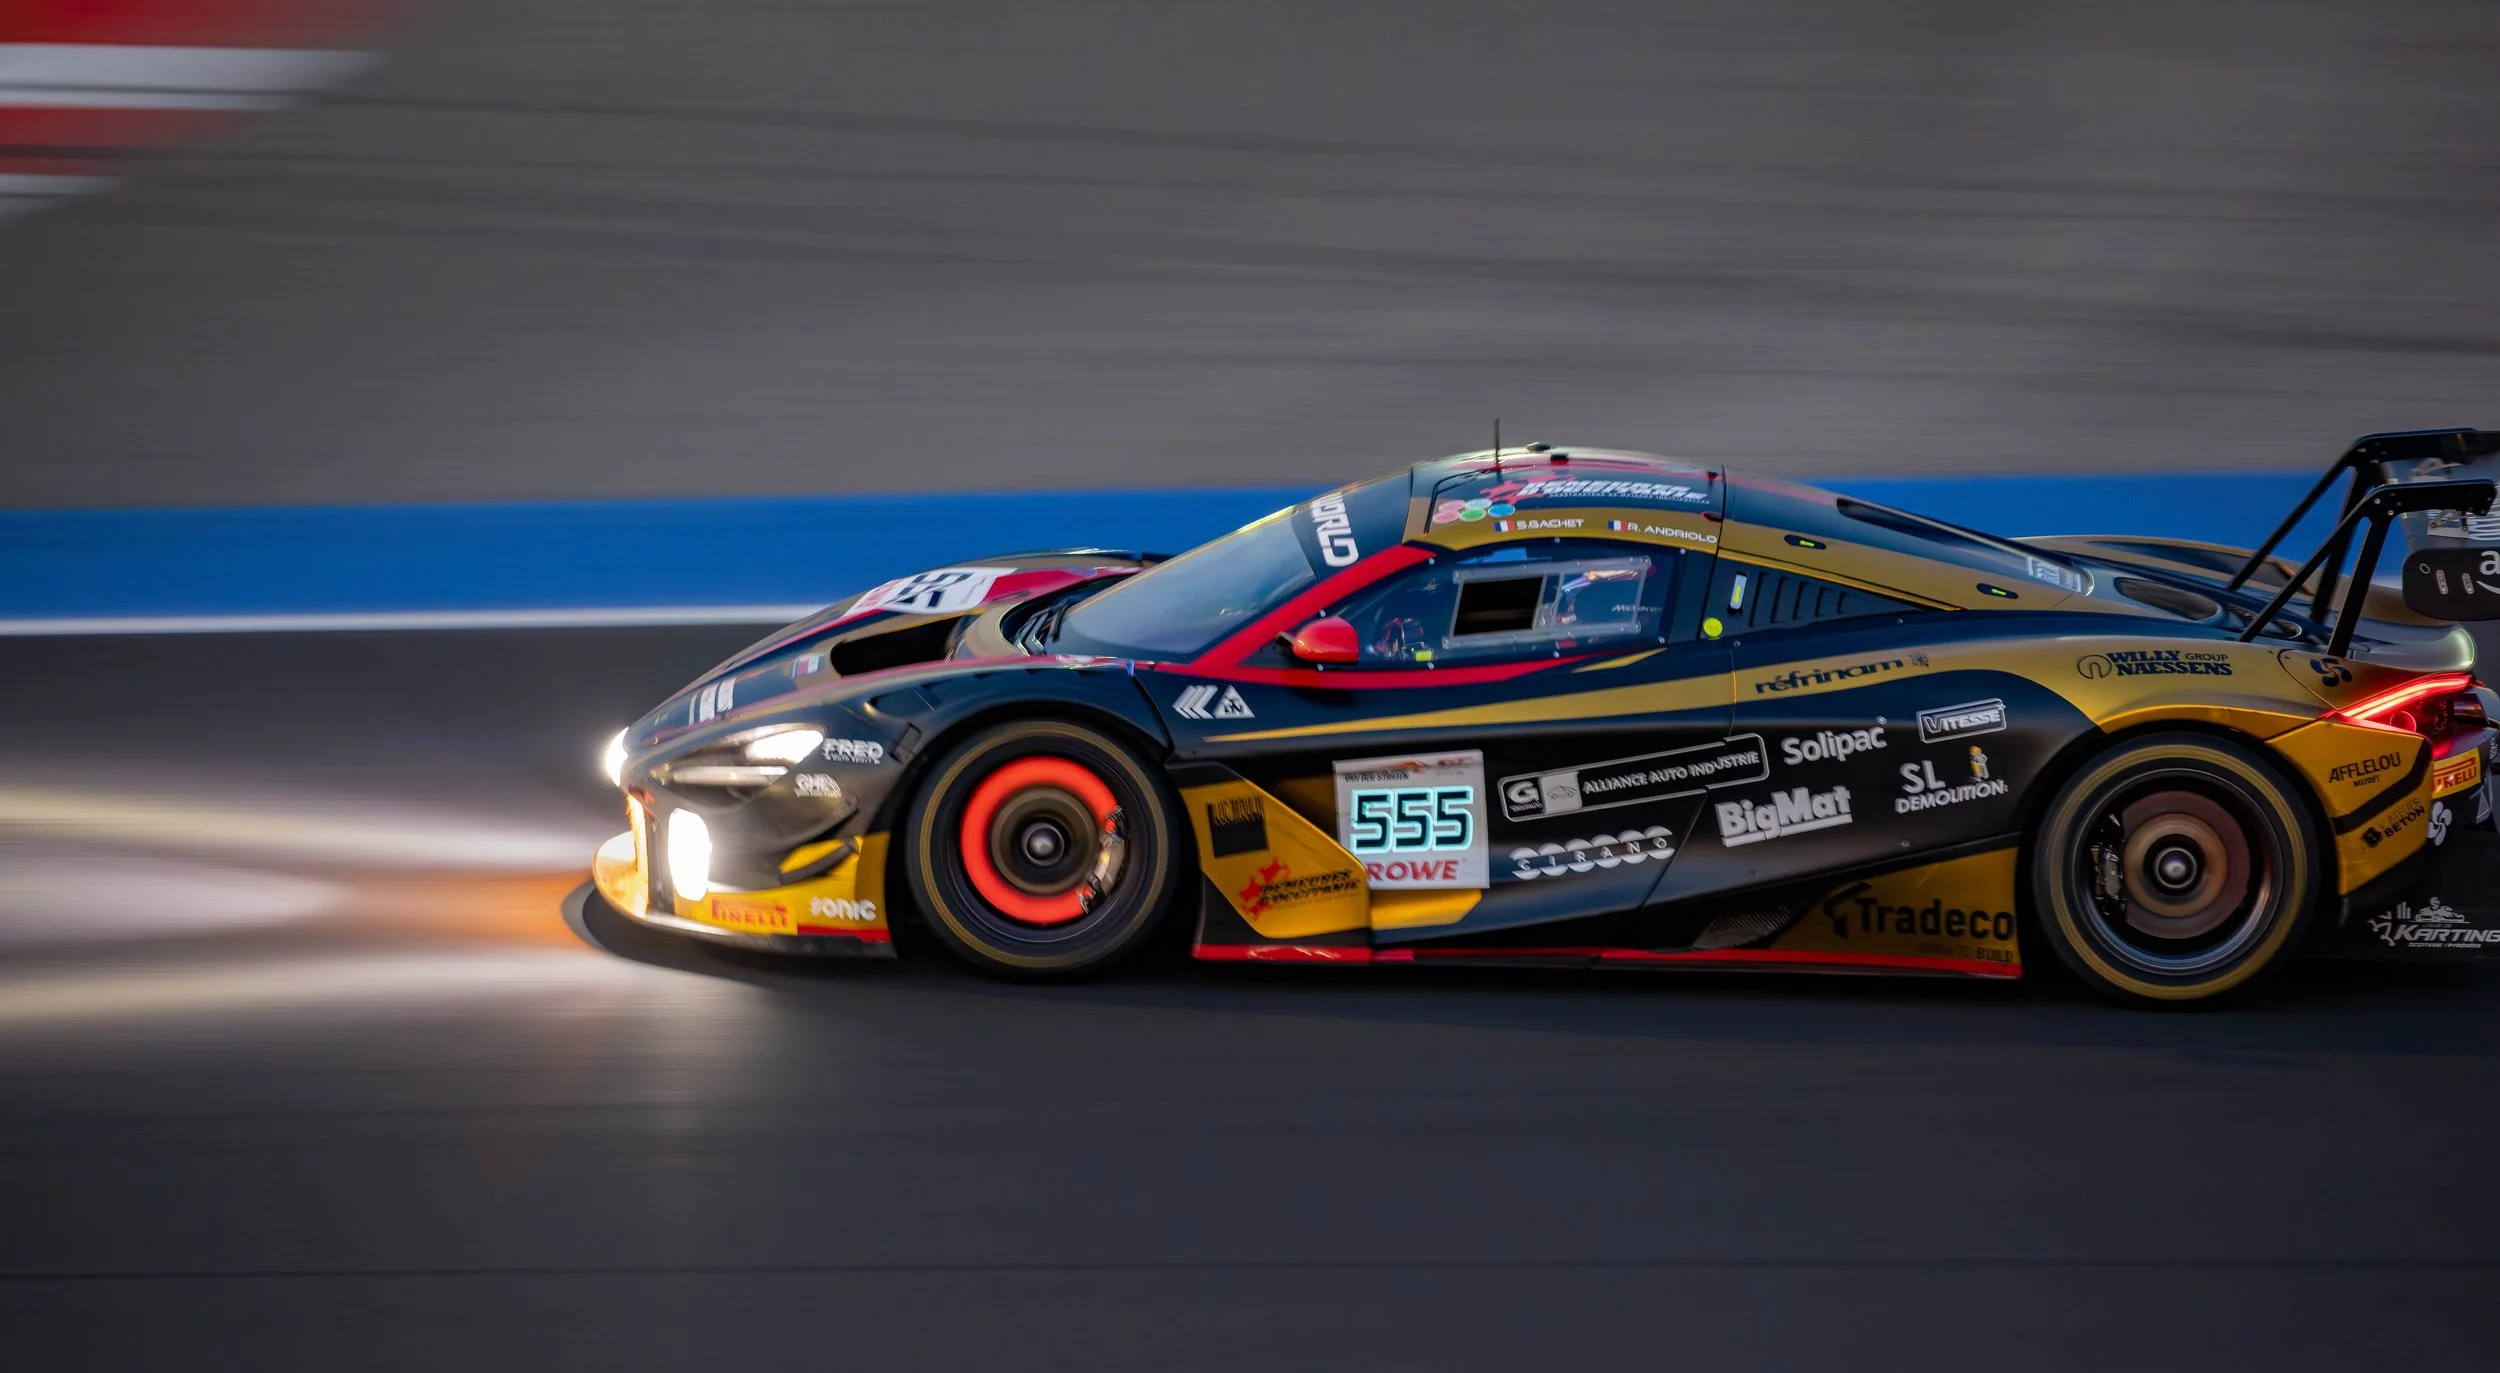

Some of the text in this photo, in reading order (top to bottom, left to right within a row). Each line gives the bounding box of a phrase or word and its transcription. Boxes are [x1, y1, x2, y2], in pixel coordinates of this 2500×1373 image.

[1644, 525, 1718, 544] ANDRIOLO
[2106, 650, 2229, 663] WILLY GROUP
[2115, 662, 2233, 676] NAESSENS
[1781, 726, 1887, 766] Solipac
[1583, 751, 1760, 794] ALLIANCE AUTO INDUSTRIE
[1900, 760, 1947, 794] SL
[2328, 751, 2401, 784] AFFLELOU
[2353, 775, 2380, 787] MURET
[1714, 785, 1852, 839] BigMat
[1894, 779, 2005, 814] DEMOLITION
[1351, 786, 1473, 854] 555
[2384, 805, 2426, 838] BETON
[1366, 860, 1459, 881] ROWE
[711, 899, 788, 928] PIRELLI
[1853, 898, 2015, 941] Tradeco
[2394, 924, 2500, 943] KARTING
